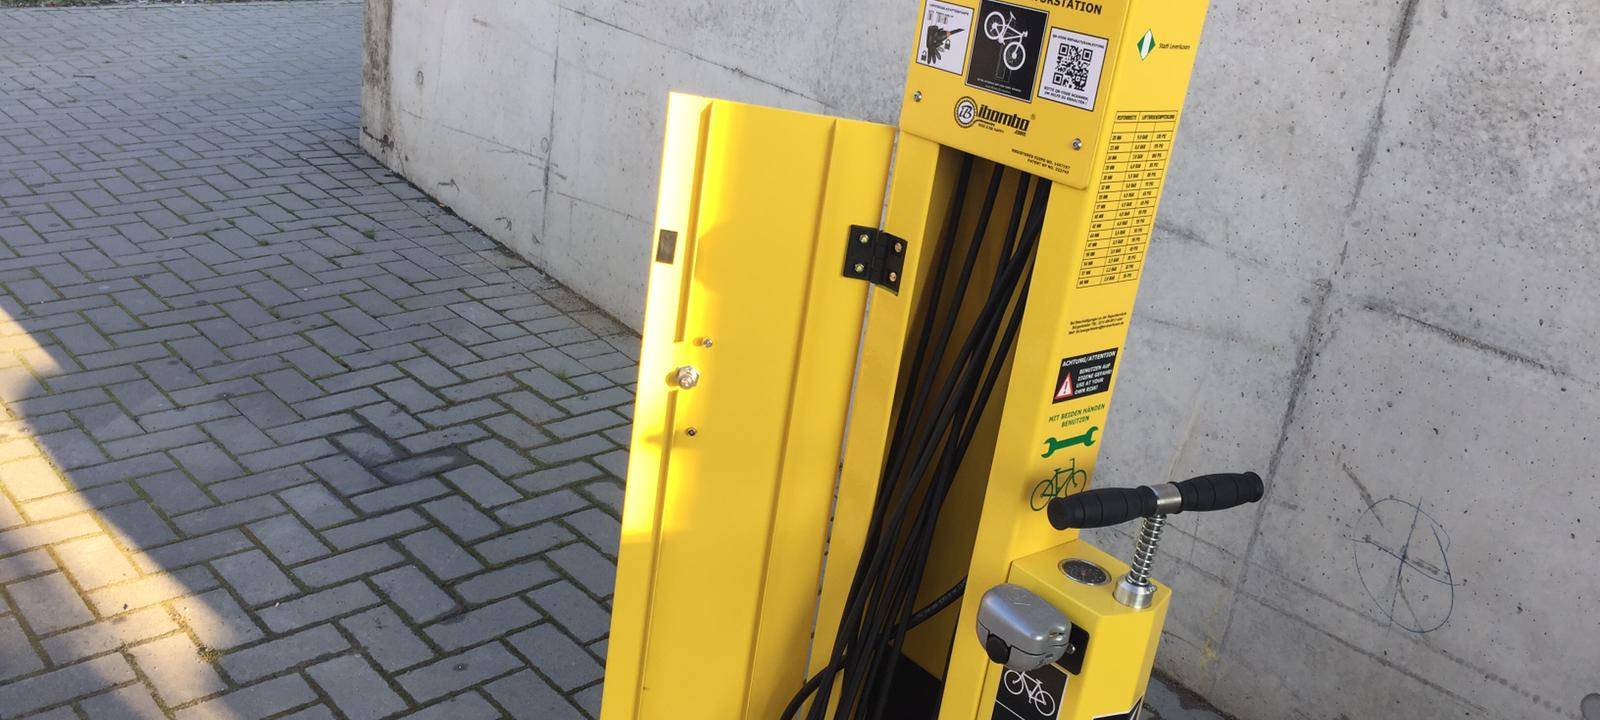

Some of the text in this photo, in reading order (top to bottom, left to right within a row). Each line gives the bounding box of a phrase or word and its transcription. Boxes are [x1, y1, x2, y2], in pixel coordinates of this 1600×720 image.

[978, 104, 1030, 131] ibombo
[1062, 351, 1116, 366] ACHTUNG/ATTENTION
[1080, 366, 1101, 374] BENUTZEN
[1049, 403, 1105, 422] MIT BEIDEN HÄNDEN
[1061, 416, 1089, 428] BENUTZEN
